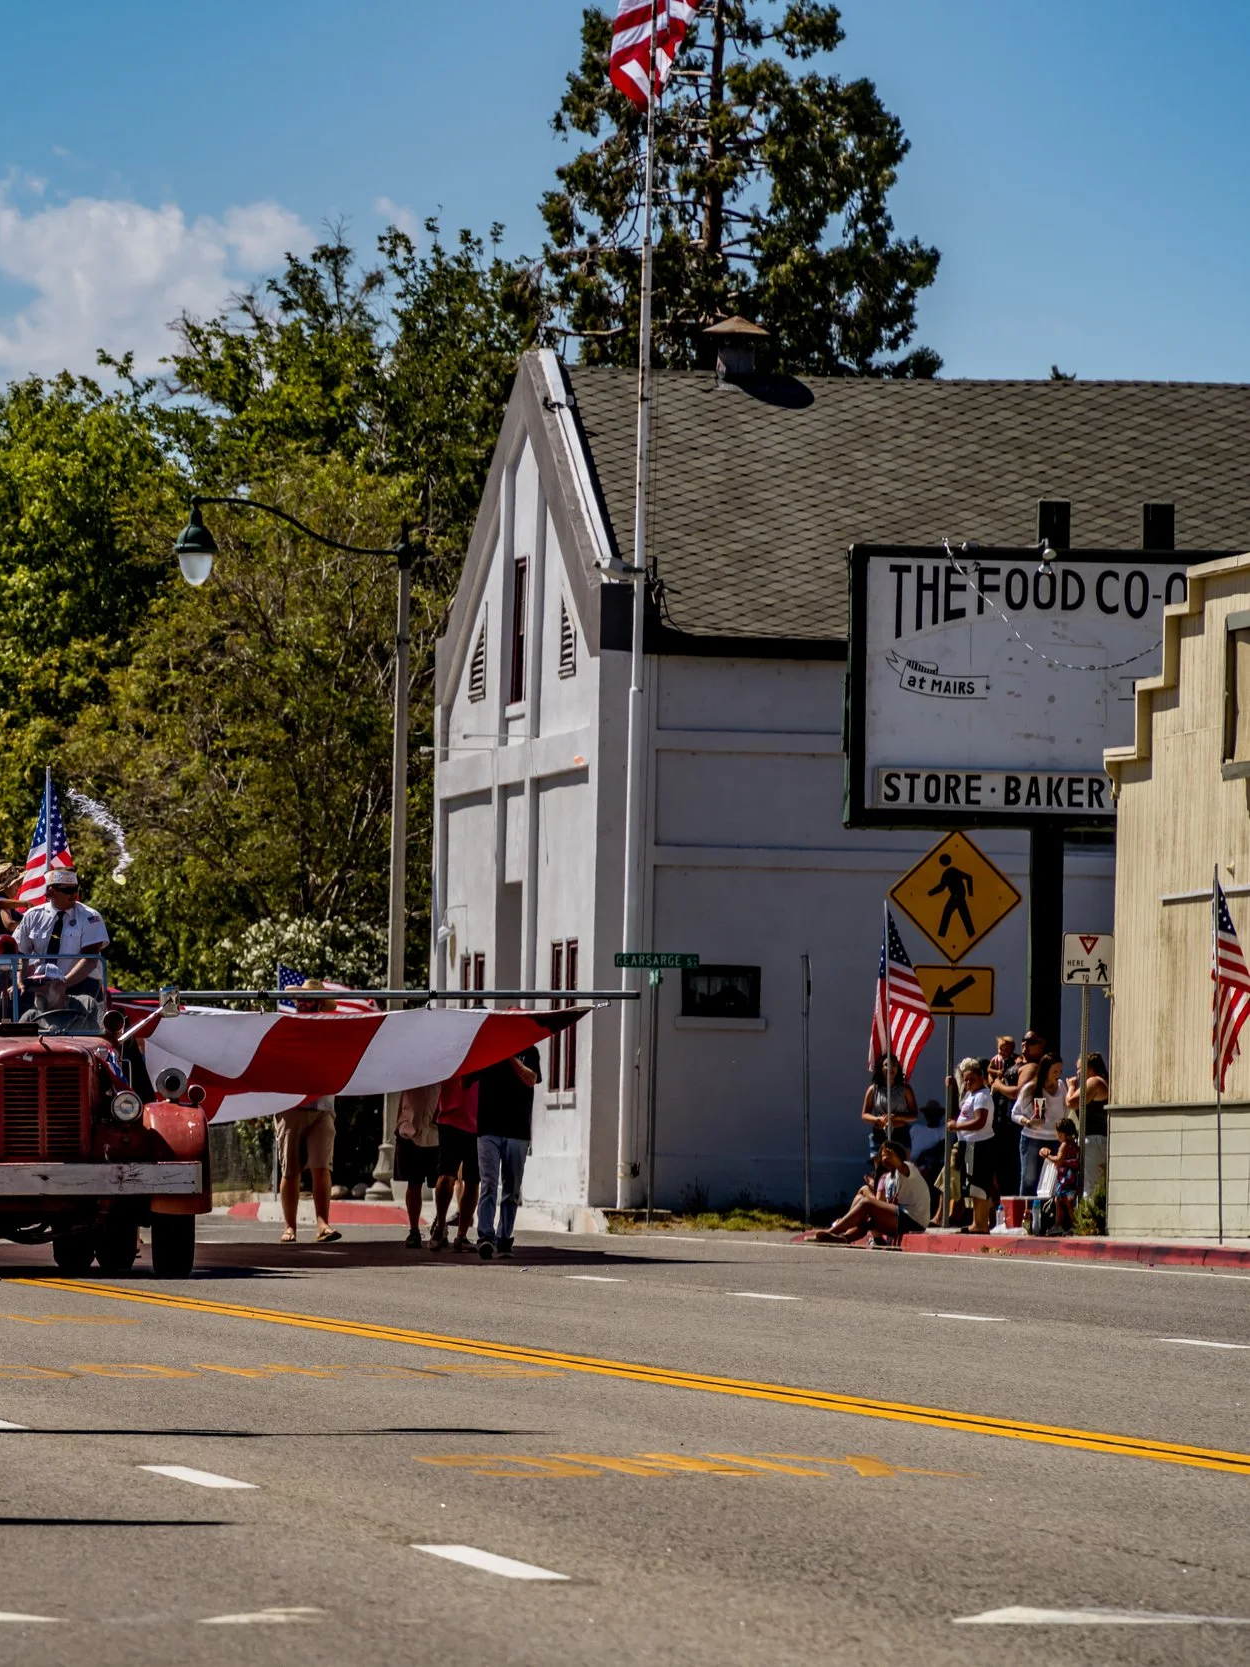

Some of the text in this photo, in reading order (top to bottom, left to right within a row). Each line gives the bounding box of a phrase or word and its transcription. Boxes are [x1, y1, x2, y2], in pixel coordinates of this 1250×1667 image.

[889, 564, 967, 640] THE
[977, 566, 1086, 616] FOOD
[907, 675, 975, 695] at MAIRS
[883, 772, 982, 806] STORE
[616, 955, 681, 966] KEARSARGE
